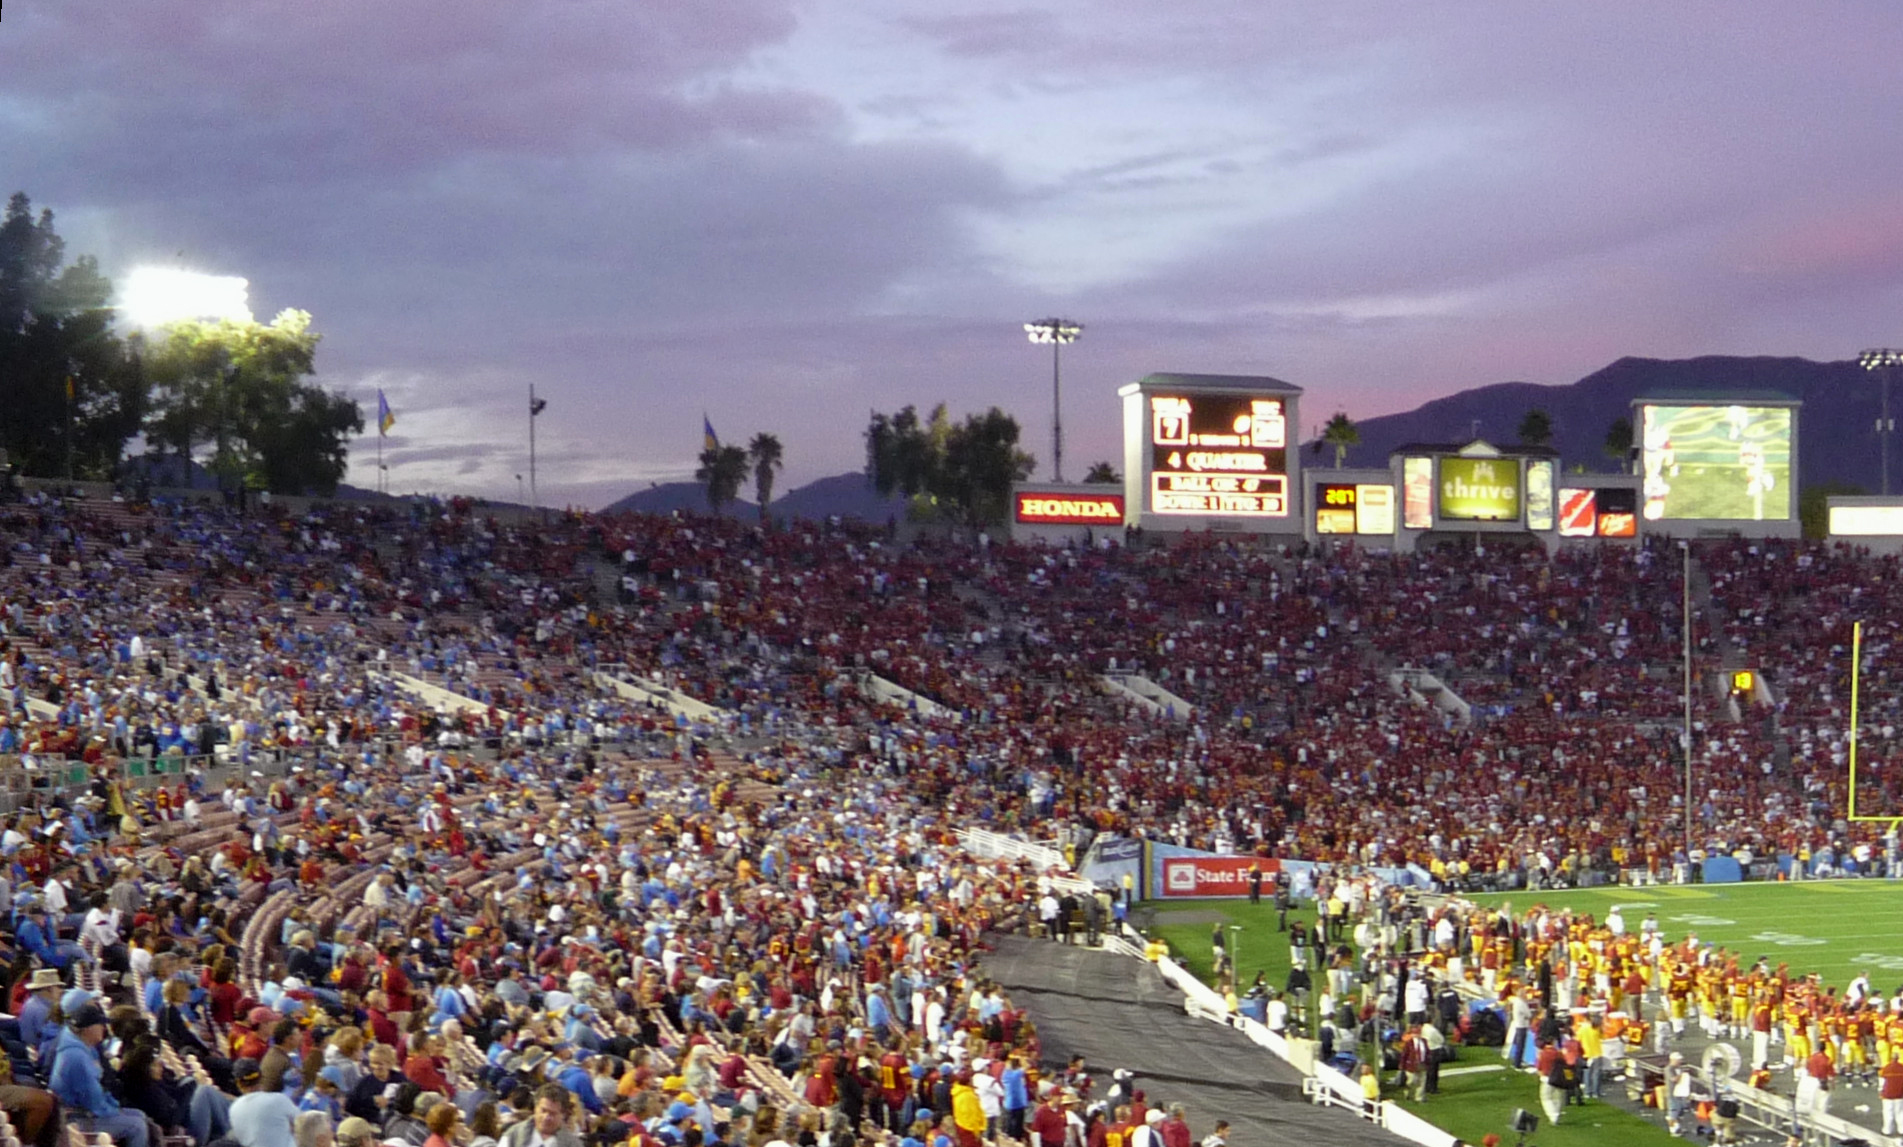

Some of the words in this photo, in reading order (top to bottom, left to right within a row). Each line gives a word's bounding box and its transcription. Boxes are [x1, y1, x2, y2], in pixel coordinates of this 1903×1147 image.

[1445, 476, 1516, 499] thrive
[1020, 499, 1120, 517] HONDA
[1196, 868, 1235, 883] State
[1237, 868, 1277, 884] Frm
